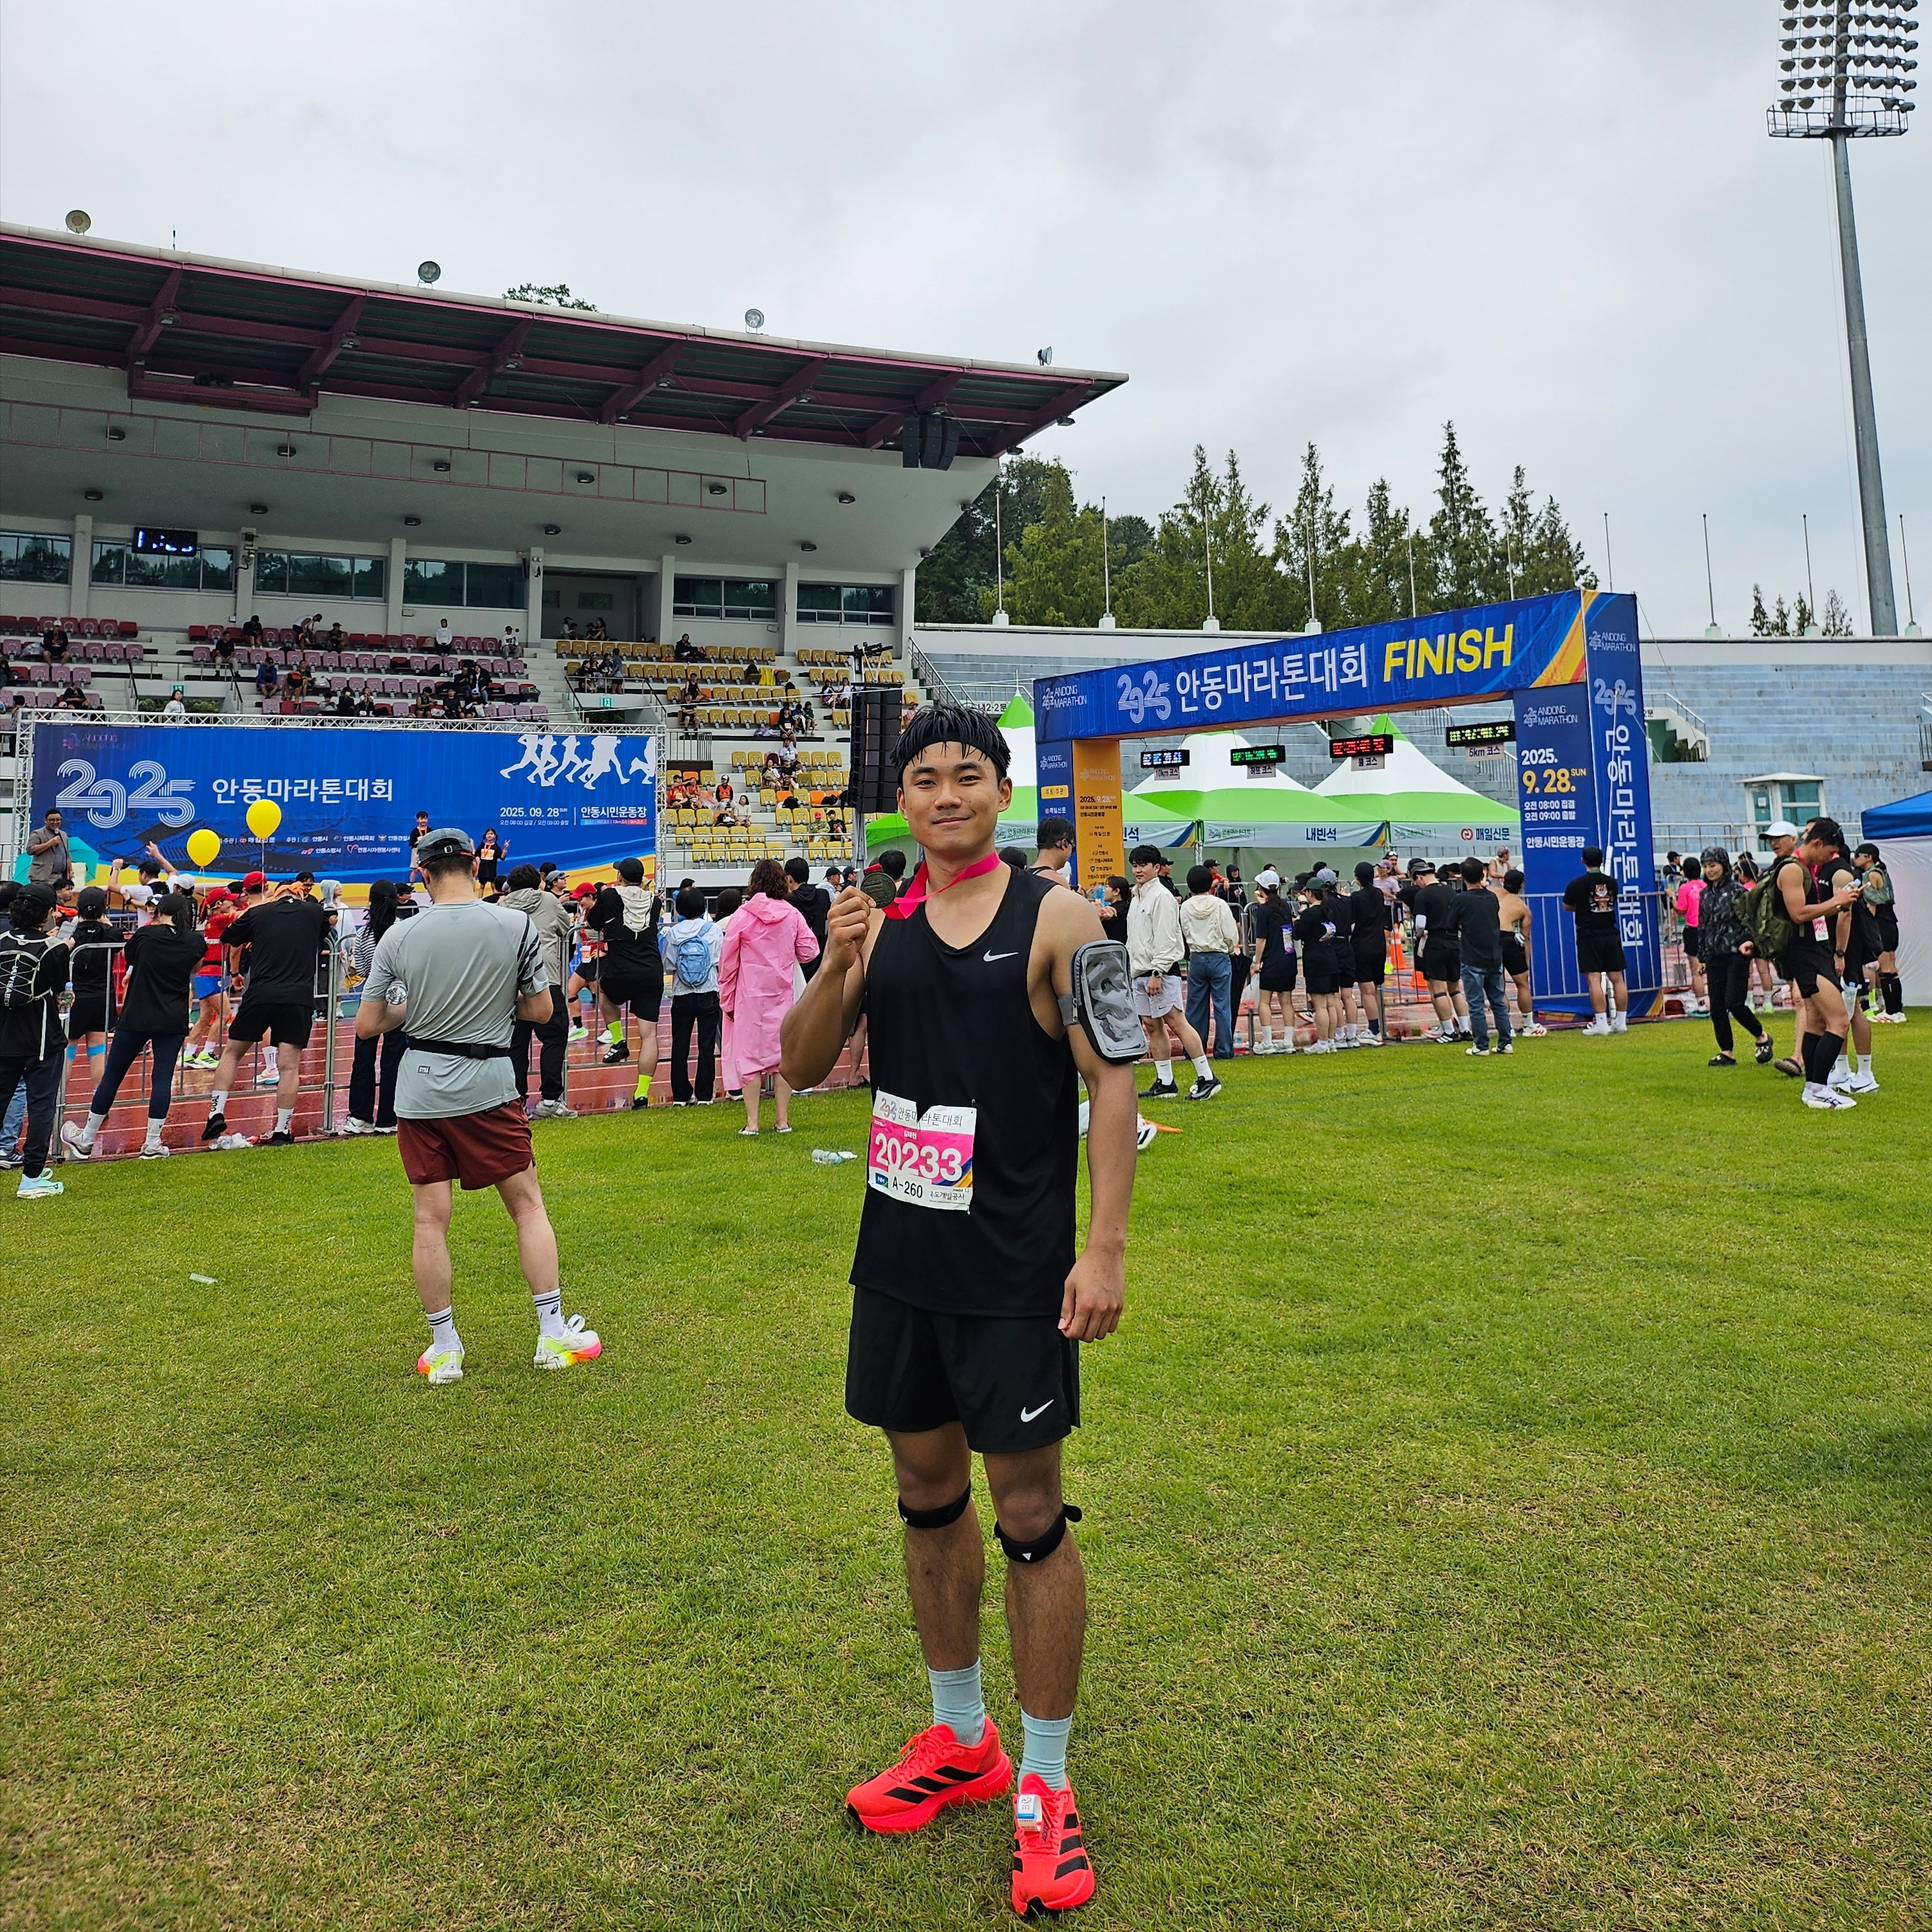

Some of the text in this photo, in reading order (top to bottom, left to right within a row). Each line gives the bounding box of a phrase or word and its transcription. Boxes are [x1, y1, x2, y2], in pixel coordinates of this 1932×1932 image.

[1602, 632, 1626, 642] ANDONG
[1383, 624, 1513, 682] FINISH
[1601, 642, 1636, 652] MARATHON
[1117, 643, 1367, 723] 2025 안동마라톤대회
[1054, 685, 1077, 697] ANDONG
[1054, 695, 1087, 708] MARATHON
[1537, 705, 1566, 715] ANDONG
[1537, 714, 1578, 726] MARATHON
[1469, 746, 1501, 757] 5km 코스
[1521, 748, 1558, 765] 2025.
[1156, 769, 1169, 777] 10km
[1262, 766, 1273, 774] 코스
[1522, 770, 1540, 794] 9.
[1543, 768, 1576, 793] 28.
[55, 759, 392, 829] 2025 안동마라톤대회
[1524, 801, 1537, 811] 오전
[1538, 800, 1560, 810] 08:00
[500, 807, 527, 817] 2025.
[529, 807, 545, 817] 09.
[547, 807, 560, 817] 28
[580, 806, 647, 818] 안동시민운동장
[1524, 812, 1538, 822] 오전
[1539, 811, 1560, 820] 09:00
[1305, 828, 1336, 842] 내빈석
[1476, 828, 1510, 842] 매일신문
[1605, 724, 1643, 947] 안동마라톤대회
[1526, 835, 1586, 849] 안동시민운동장
[875, 1132, 963, 1182] 20233
[892, 1177, 923, 1198] A-260
